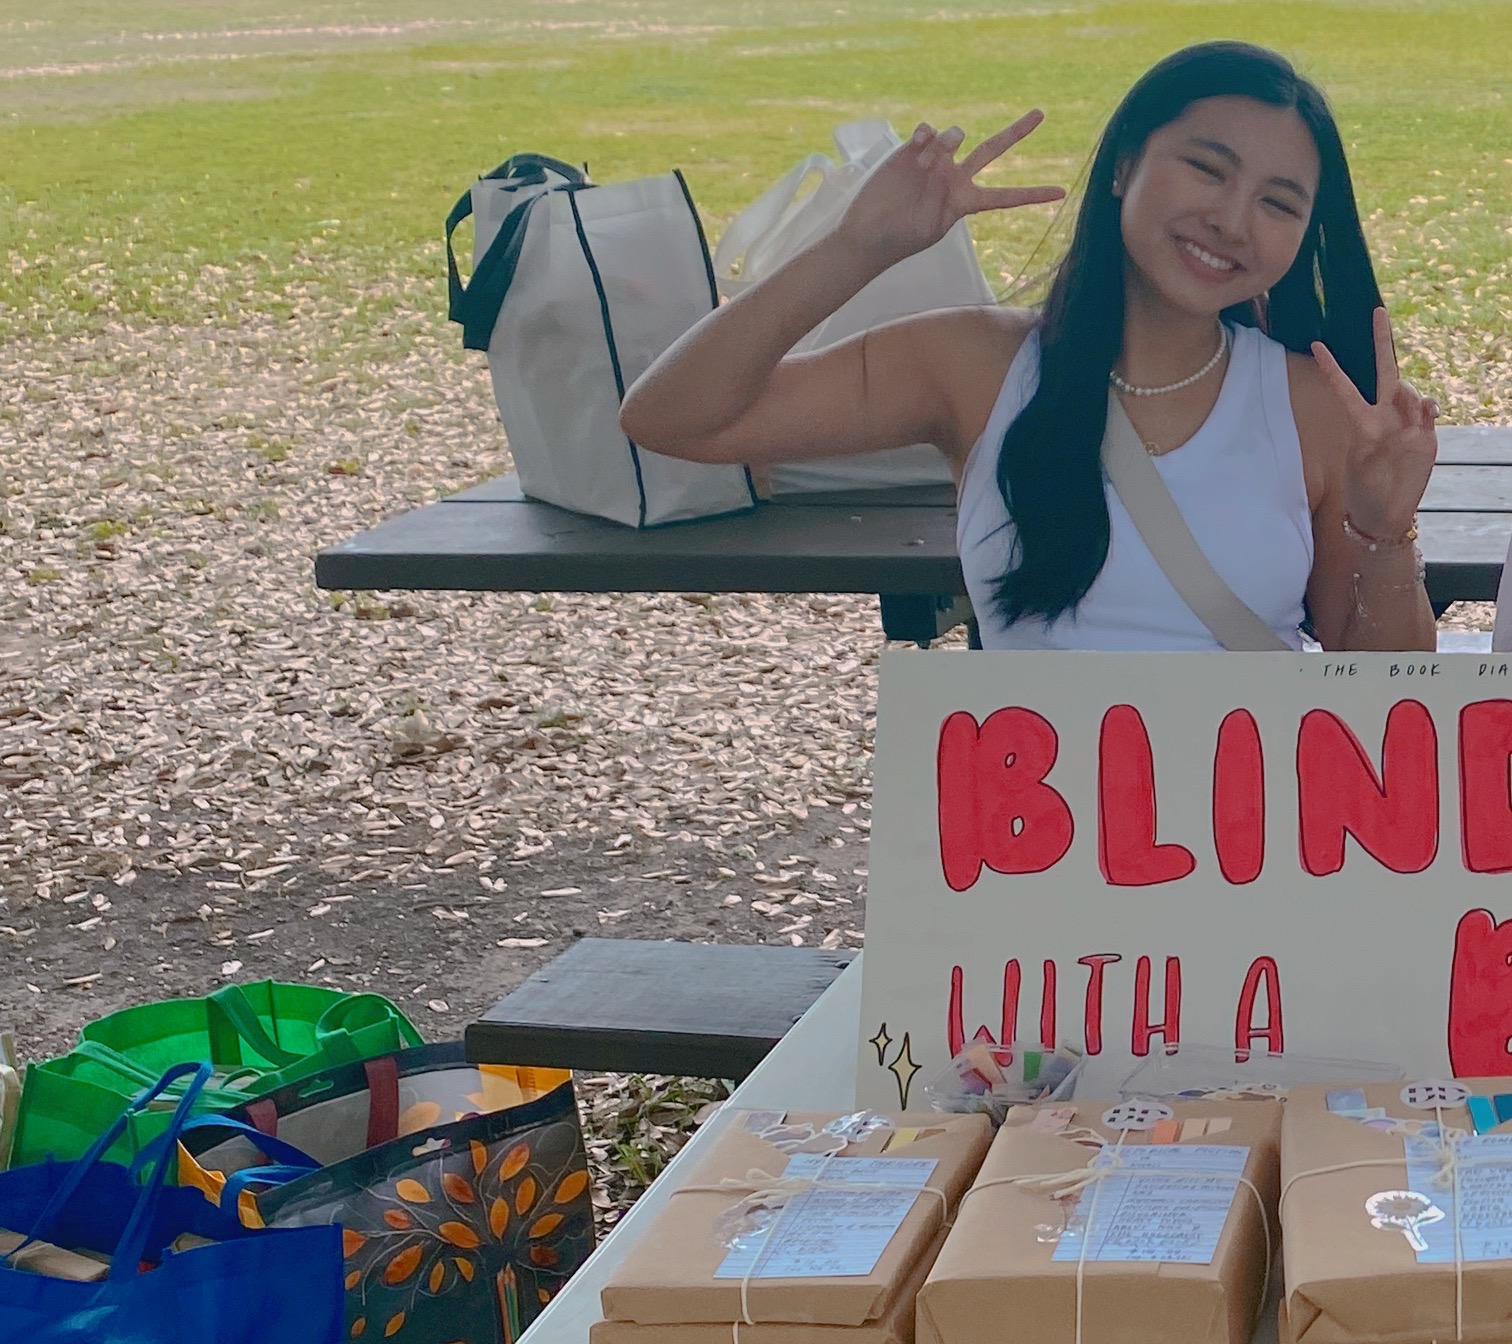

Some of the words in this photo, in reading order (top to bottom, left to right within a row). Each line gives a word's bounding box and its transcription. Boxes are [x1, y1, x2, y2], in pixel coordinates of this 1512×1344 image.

[1322, 663, 1359, 677] THE
[1389, 664, 1442, 678] BOOK
[948, 953, 1183, 1068] WITH
[1235, 955, 1285, 1064] A
